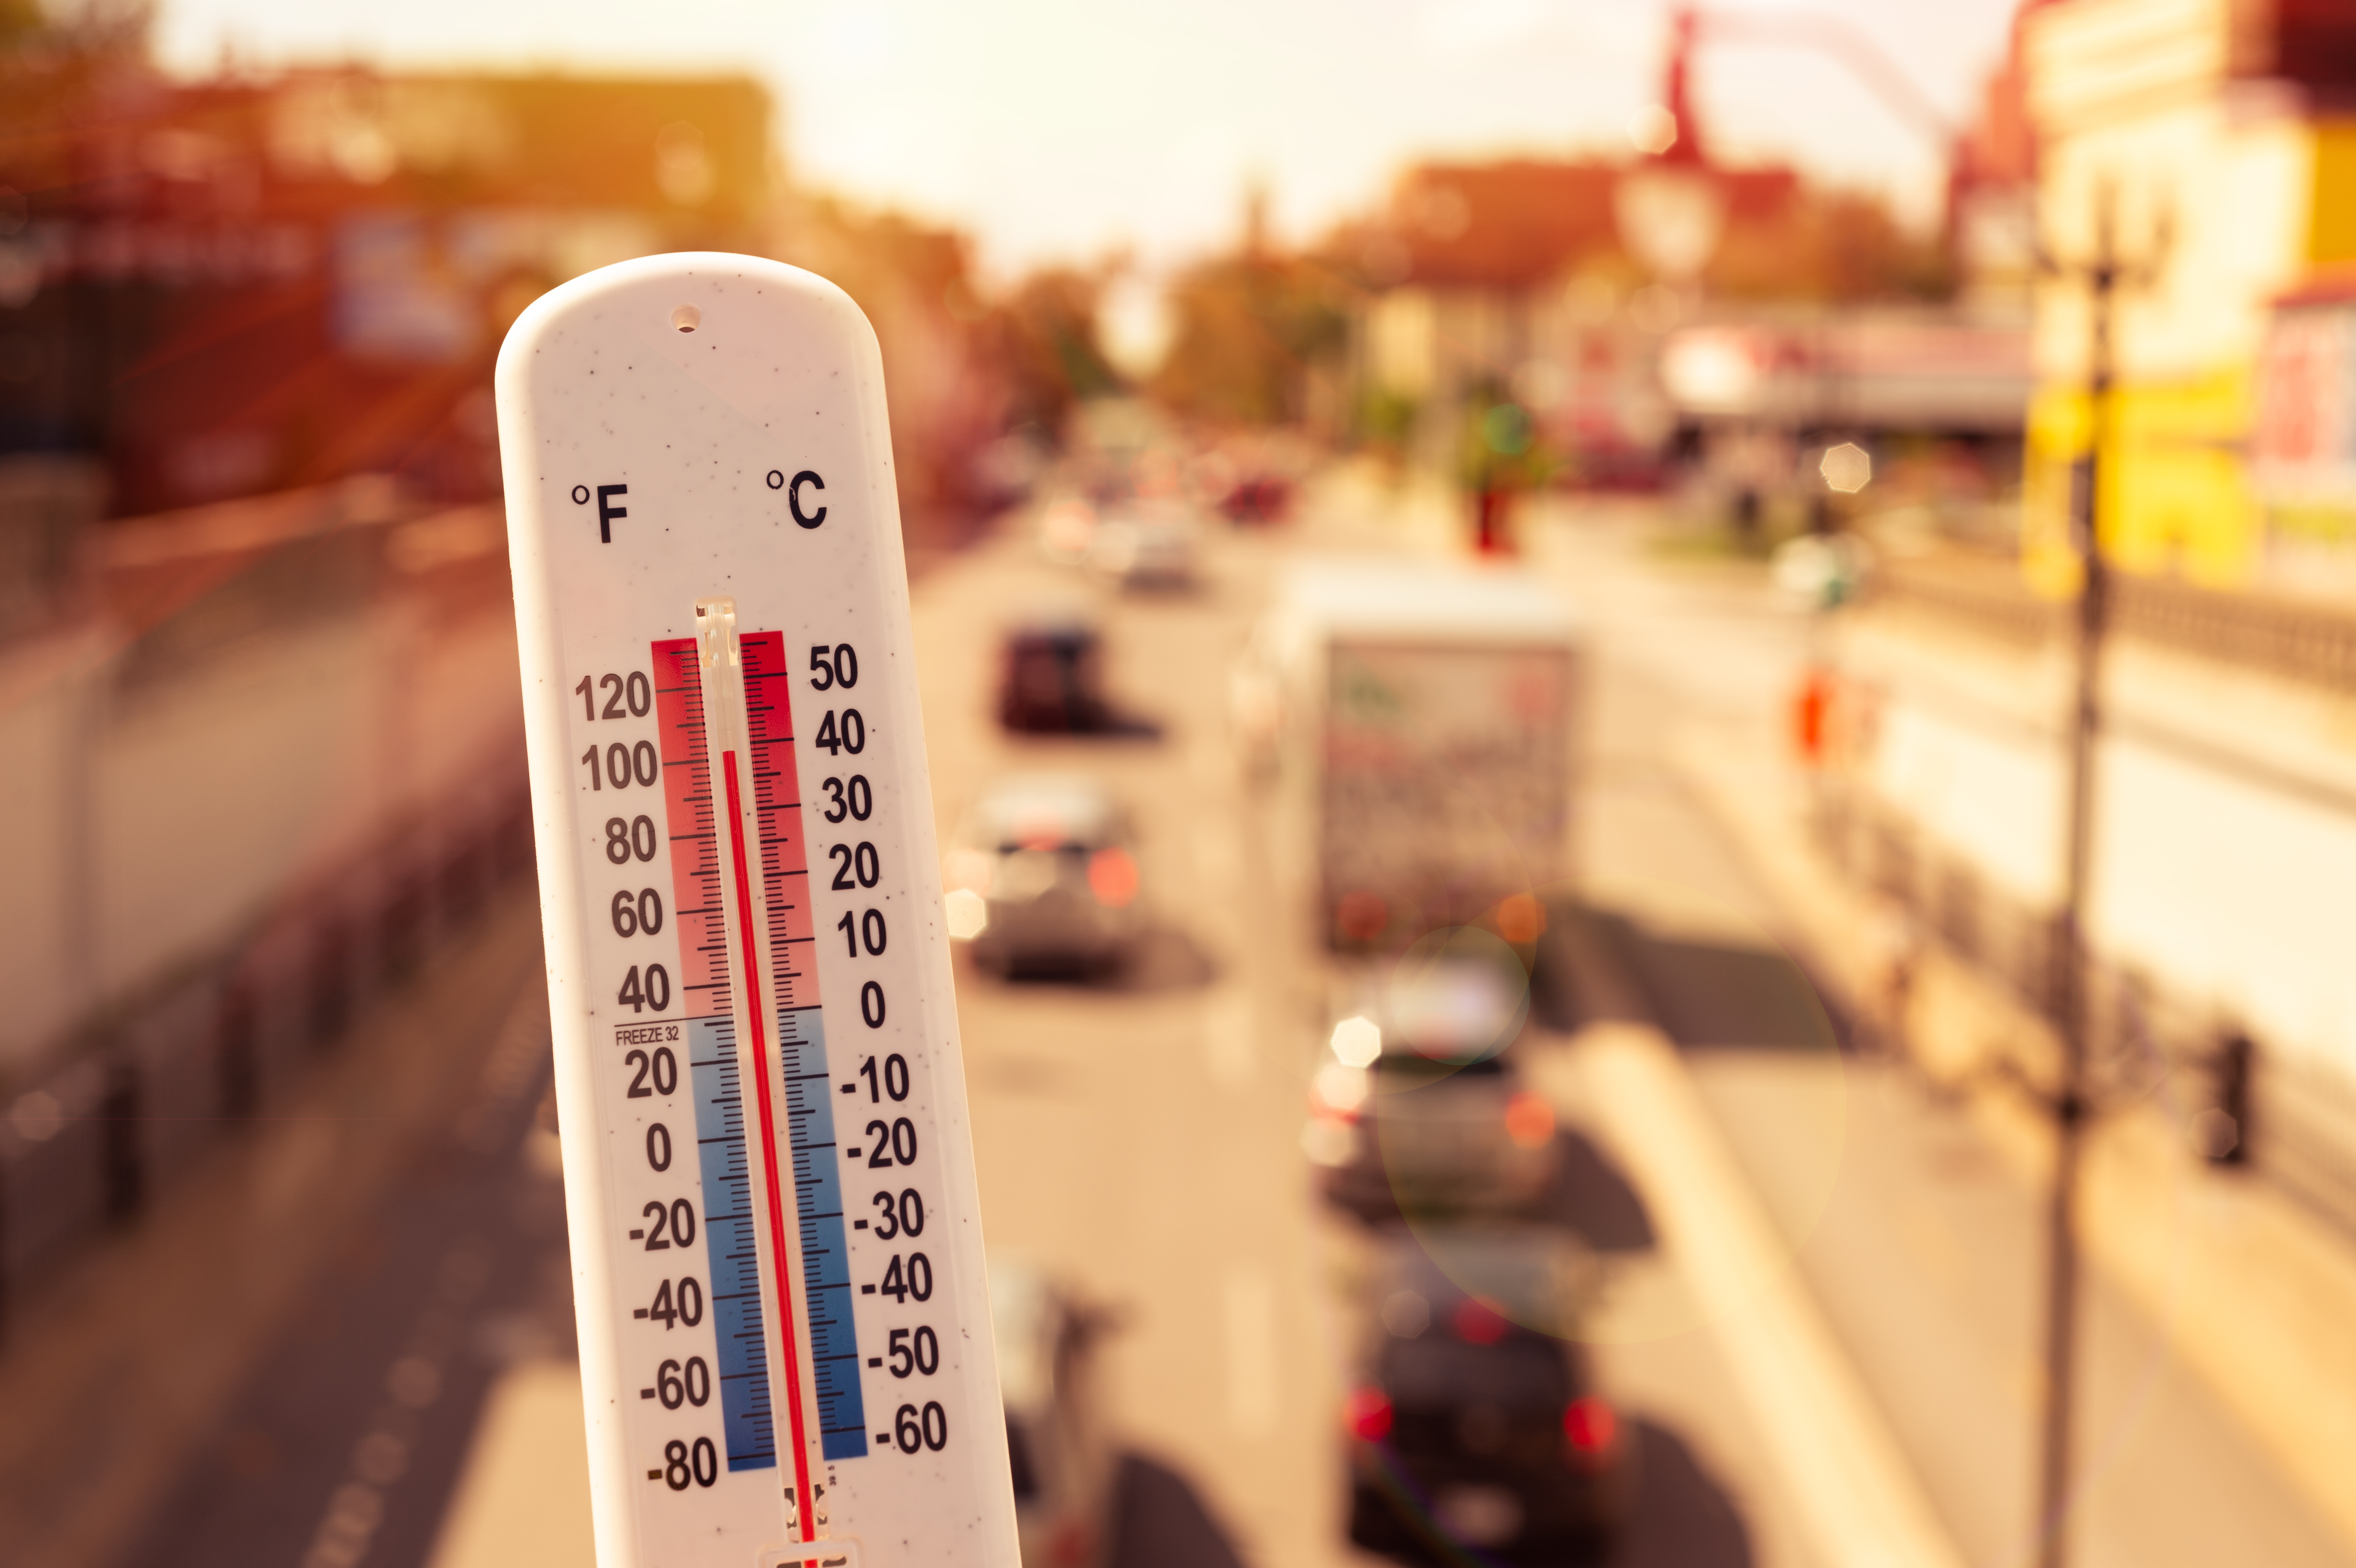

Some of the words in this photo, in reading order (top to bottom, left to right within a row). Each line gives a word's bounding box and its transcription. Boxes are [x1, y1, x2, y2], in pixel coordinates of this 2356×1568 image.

[810, 643, 858, 691] 50
[576, 671, 651, 721] 120
[816, 708, 865, 755] 40
[582, 740, 657, 791] 100
[822, 774, 872, 823] 30
[606, 815, 656, 864] 80
[829, 841, 879, 890] 20
[612, 888, 663, 937] 60
[838, 909, 886, 958] 10
[619, 964, 669, 1013] 40
[862, 981, 885, 1028] 0
[616, 1027, 663, 1046] FREEZE
[665, 1025, 679, 1041] 32
[625, 1047, 677, 1098] 20
[842, 1054, 909, 1103] -10
[647, 1123, 671, 1172] 0
[847, 1117, 916, 1168] -20
[630, 1198, 695, 1251] -20
[854, 1188, 924, 1240] -30
[862, 1252, 932, 1303] -40
[634, 1277, 702, 1330] -40
[868, 1326, 938, 1378] -50
[641, 1356, 710, 1410] -60
[876, 1401, 947, 1454] -60
[648, 1437, 717, 1491] -80
